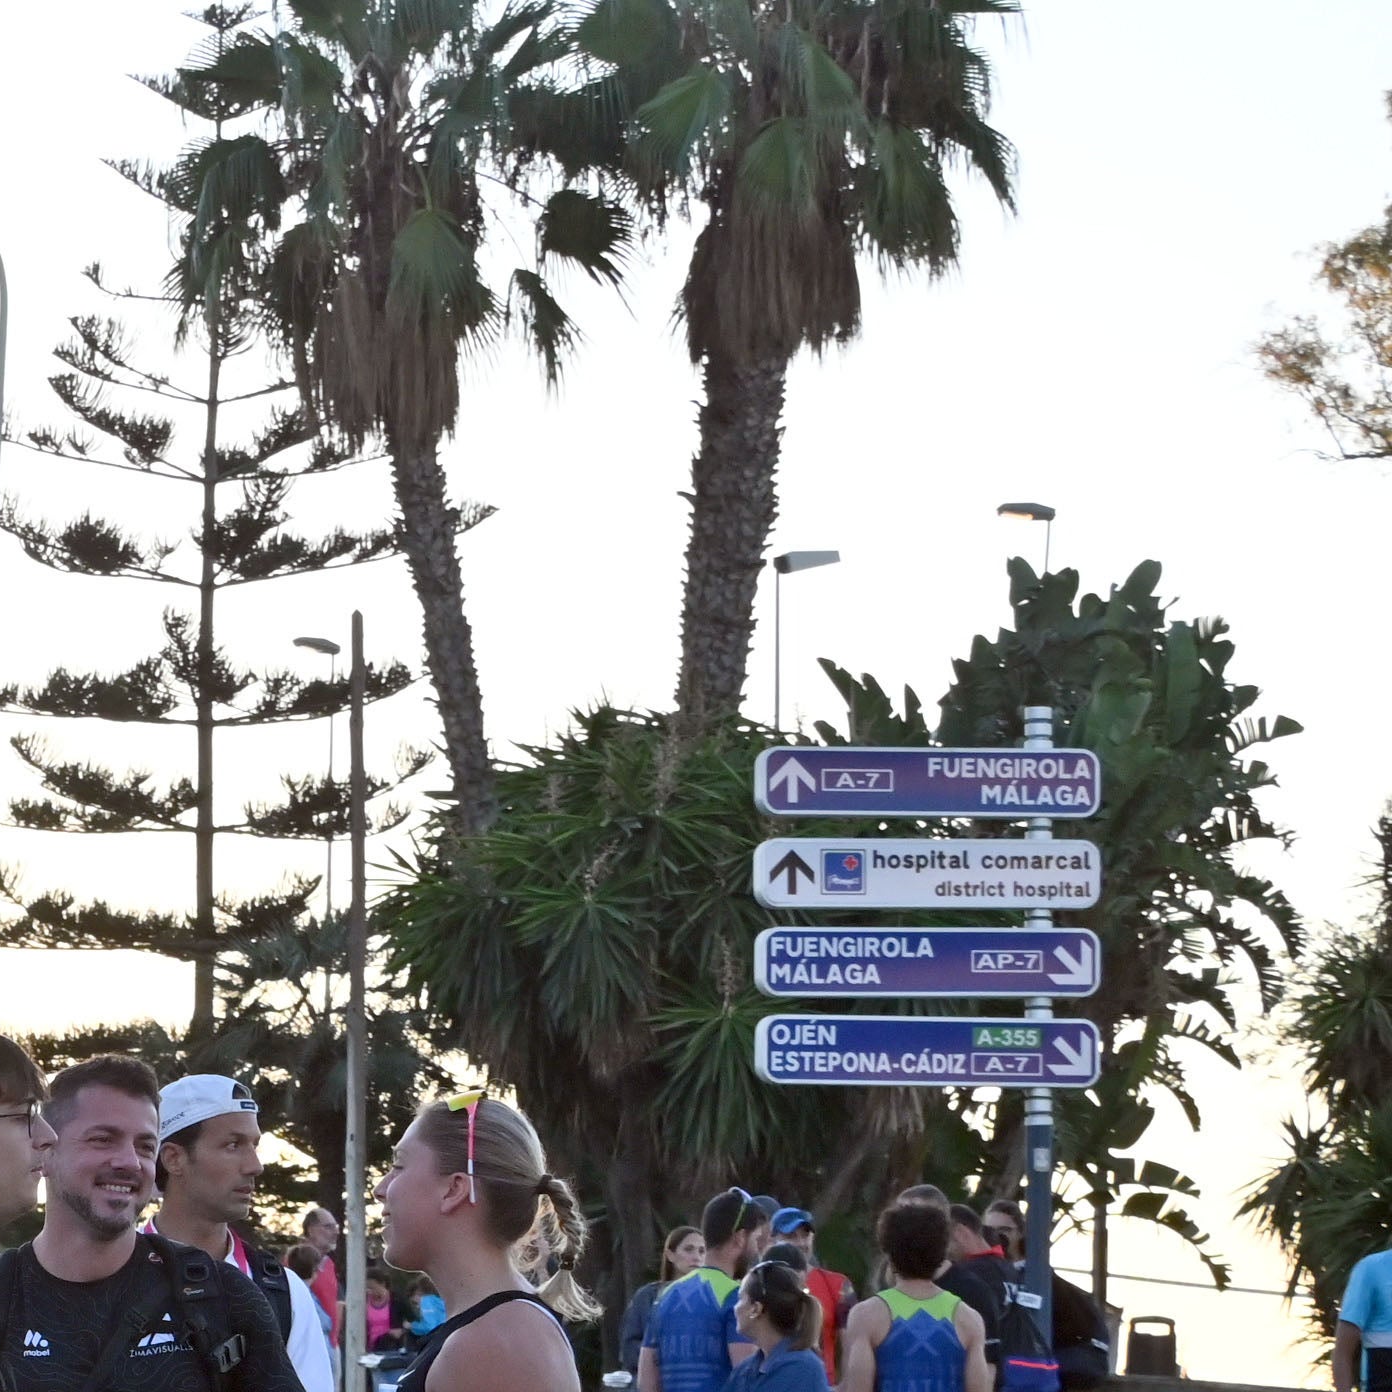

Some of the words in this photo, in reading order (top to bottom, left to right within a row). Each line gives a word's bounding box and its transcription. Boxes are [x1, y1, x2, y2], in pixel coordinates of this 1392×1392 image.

[835, 772, 880, 788] A-7
[926, 757, 1092, 780] FUENGIROLA
[980, 780, 1092, 806] MÁLAGA
[872, 849, 970, 874] hospital
[980, 850, 1092, 870] comarcal
[934, 880, 1006, 898] district
[1013, 881, 1092, 901] hospital
[769, 936, 935, 959] FUENGIROLA
[769, 957, 881, 985] MÁLAGA
[975, 953, 1040, 970] AP-7
[770, 1018, 838, 1046] OJÉN
[976, 1029, 1039, 1047] A-355
[769, 1048, 967, 1075] ESTEPONA-CÁDIZ
[984, 1056, 1029, 1071] A-7
